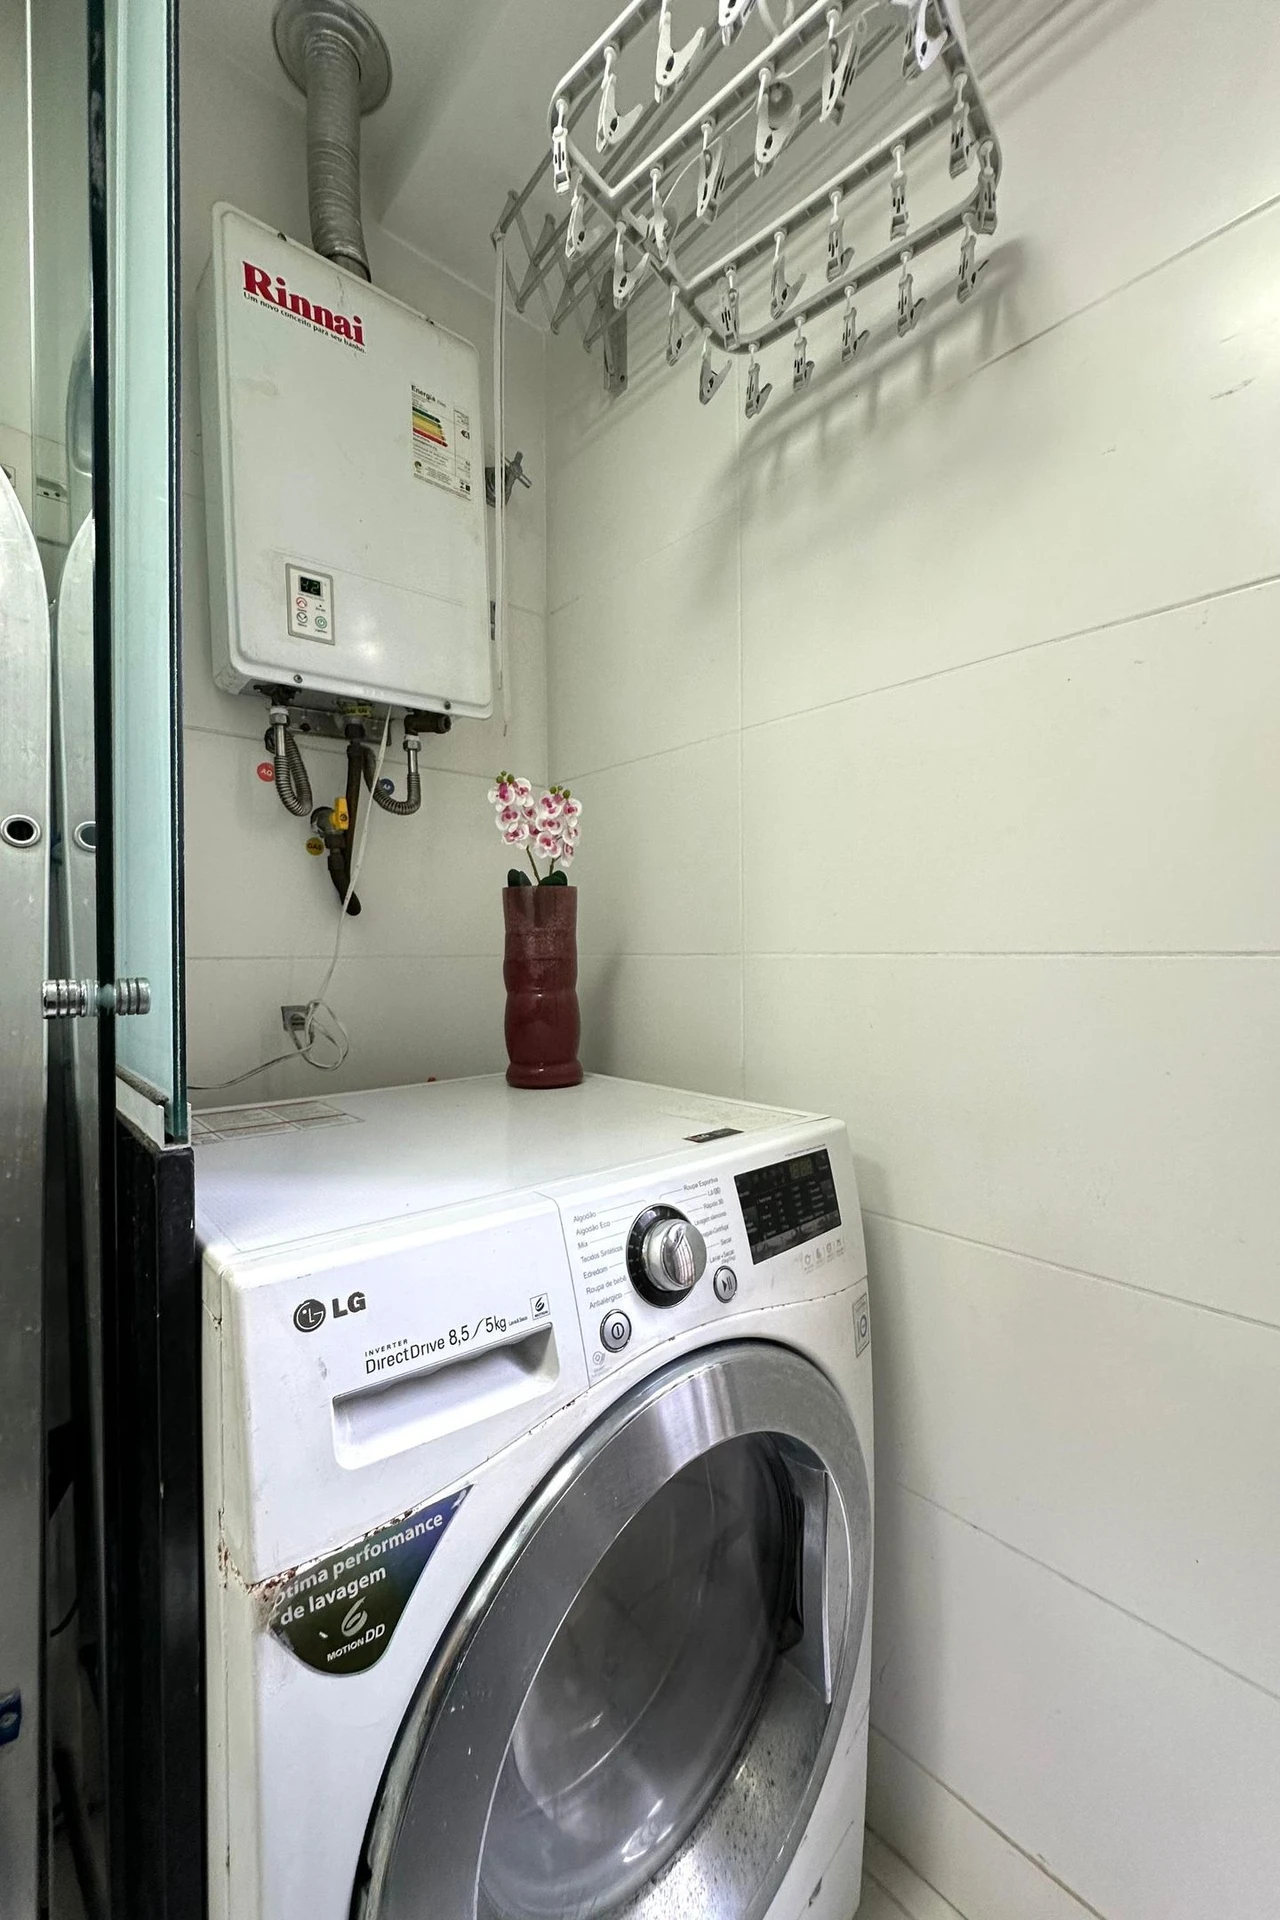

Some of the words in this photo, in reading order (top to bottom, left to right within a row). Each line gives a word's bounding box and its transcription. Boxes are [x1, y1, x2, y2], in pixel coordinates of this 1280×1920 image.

[242, 261, 365, 346] Rinnai
[243, 291, 258, 304] Um
[260, 300, 279, 313] novo
[313, 325, 329, 337] para
[331, 1291, 367, 1319] LG
[364, 1338, 408, 1358] INVERTER
[332, 1513, 443, 1580] performance
[280, 1604, 305, 1626] de
[308, 1566, 387, 1613] lavagem
